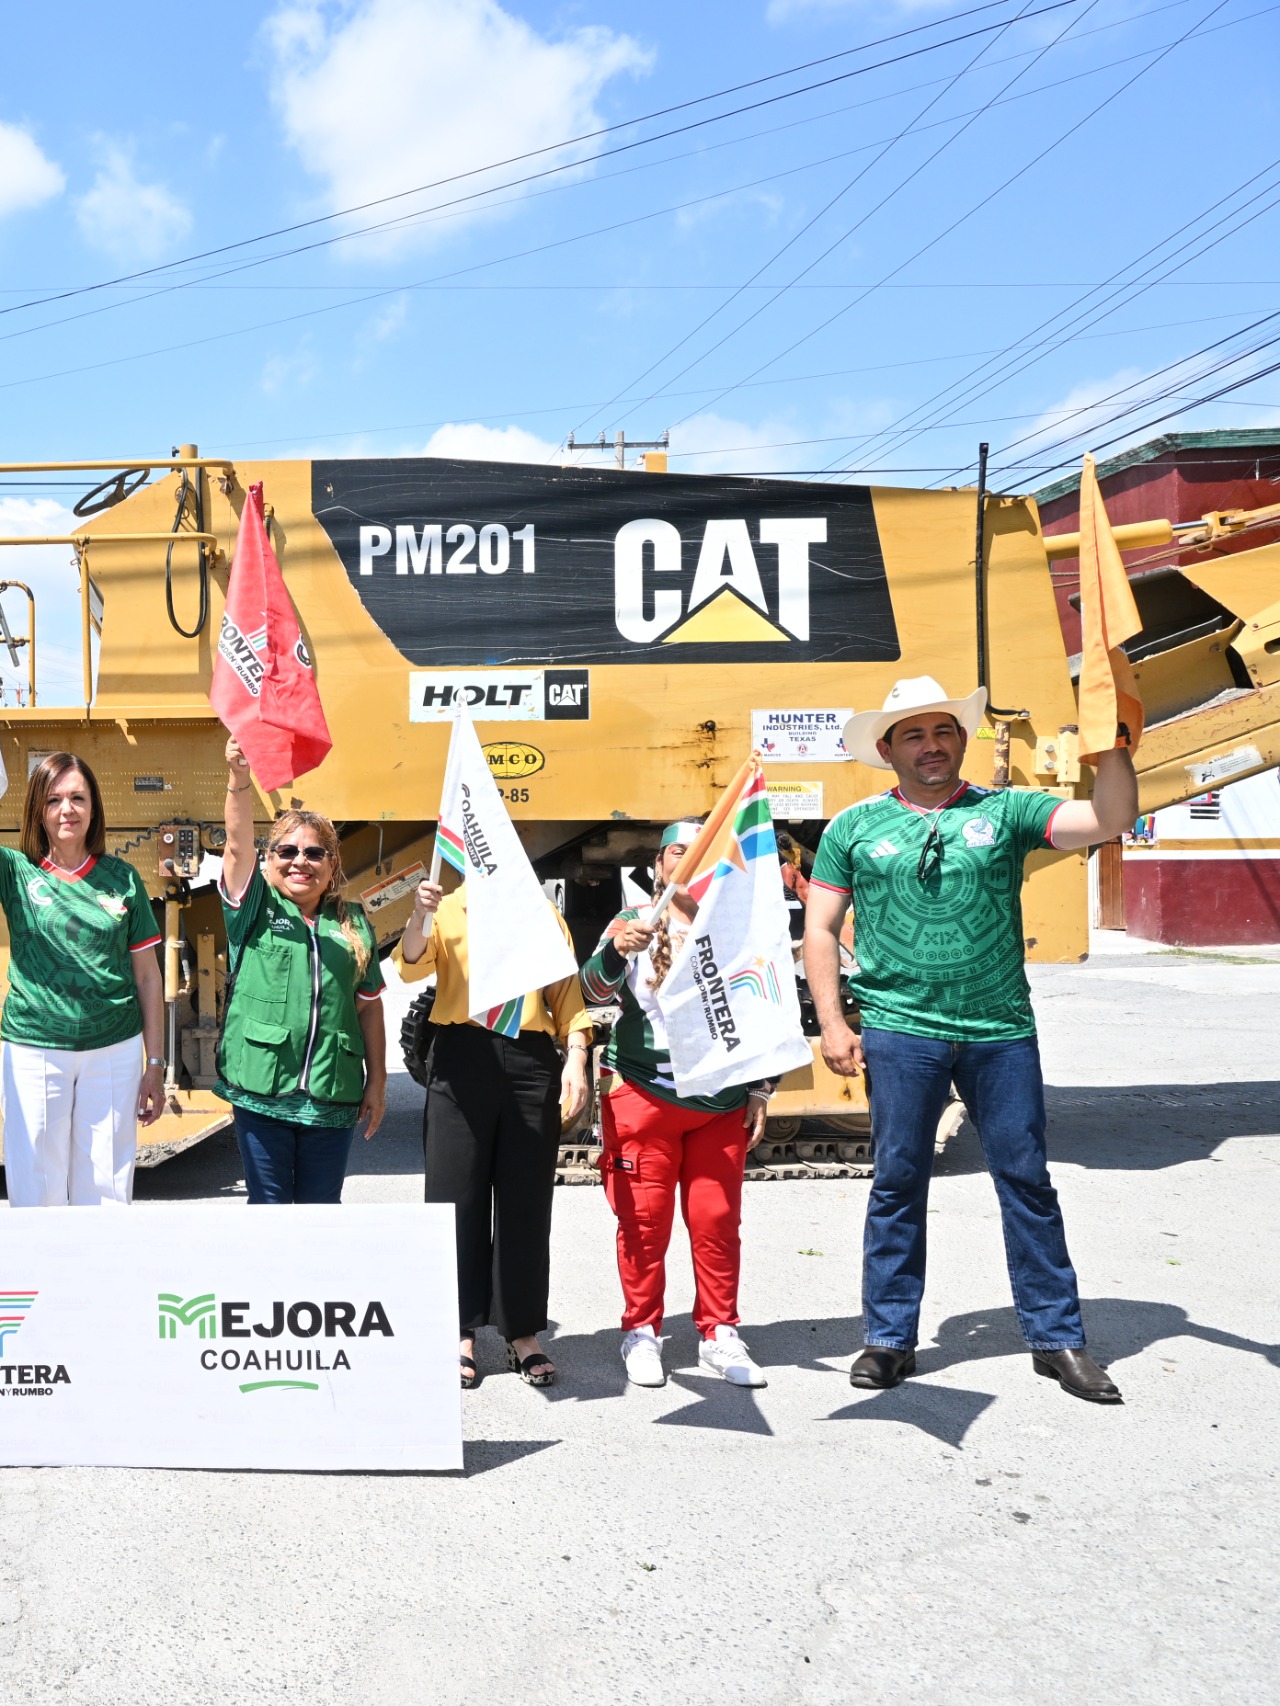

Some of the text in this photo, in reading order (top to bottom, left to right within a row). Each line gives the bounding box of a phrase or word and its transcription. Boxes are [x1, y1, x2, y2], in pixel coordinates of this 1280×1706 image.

[358, 523, 536, 576] PM201
[614, 517, 828, 643] CAT
[422, 684, 583, 707] HOLT CAT
[768, 713, 837, 724] HUNTER
[488, 753, 537, 765] MCO
[695, 934, 741, 1053] FRONTERA
[157, 1293, 395, 1339] MEJORA
[200, 1349, 352, 1371] COAHUILA
